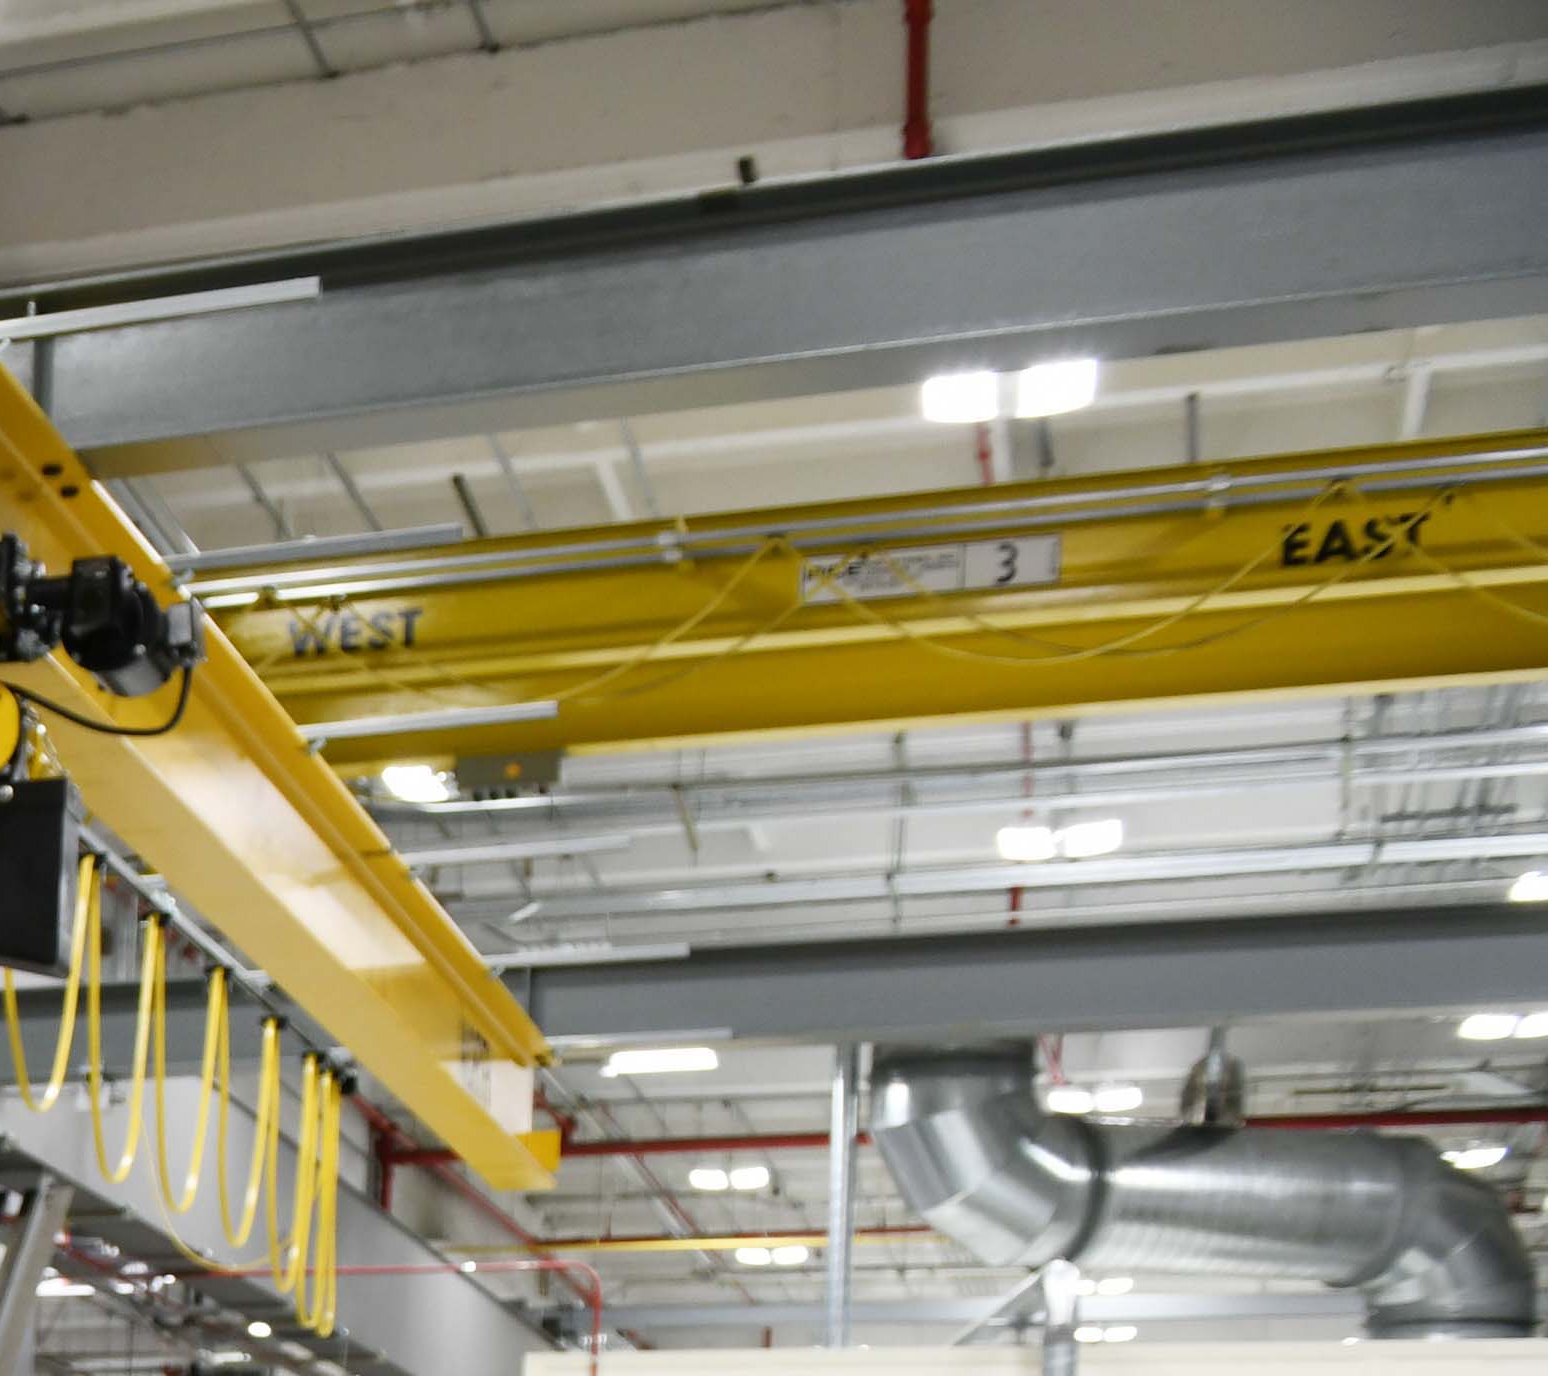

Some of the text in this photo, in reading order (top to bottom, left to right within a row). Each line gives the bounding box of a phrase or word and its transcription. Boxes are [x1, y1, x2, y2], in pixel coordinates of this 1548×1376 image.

[1282, 513, 1429, 565] EAST
[997, 543, 1018, 584] 3
[288, 608, 423, 656] WEST
